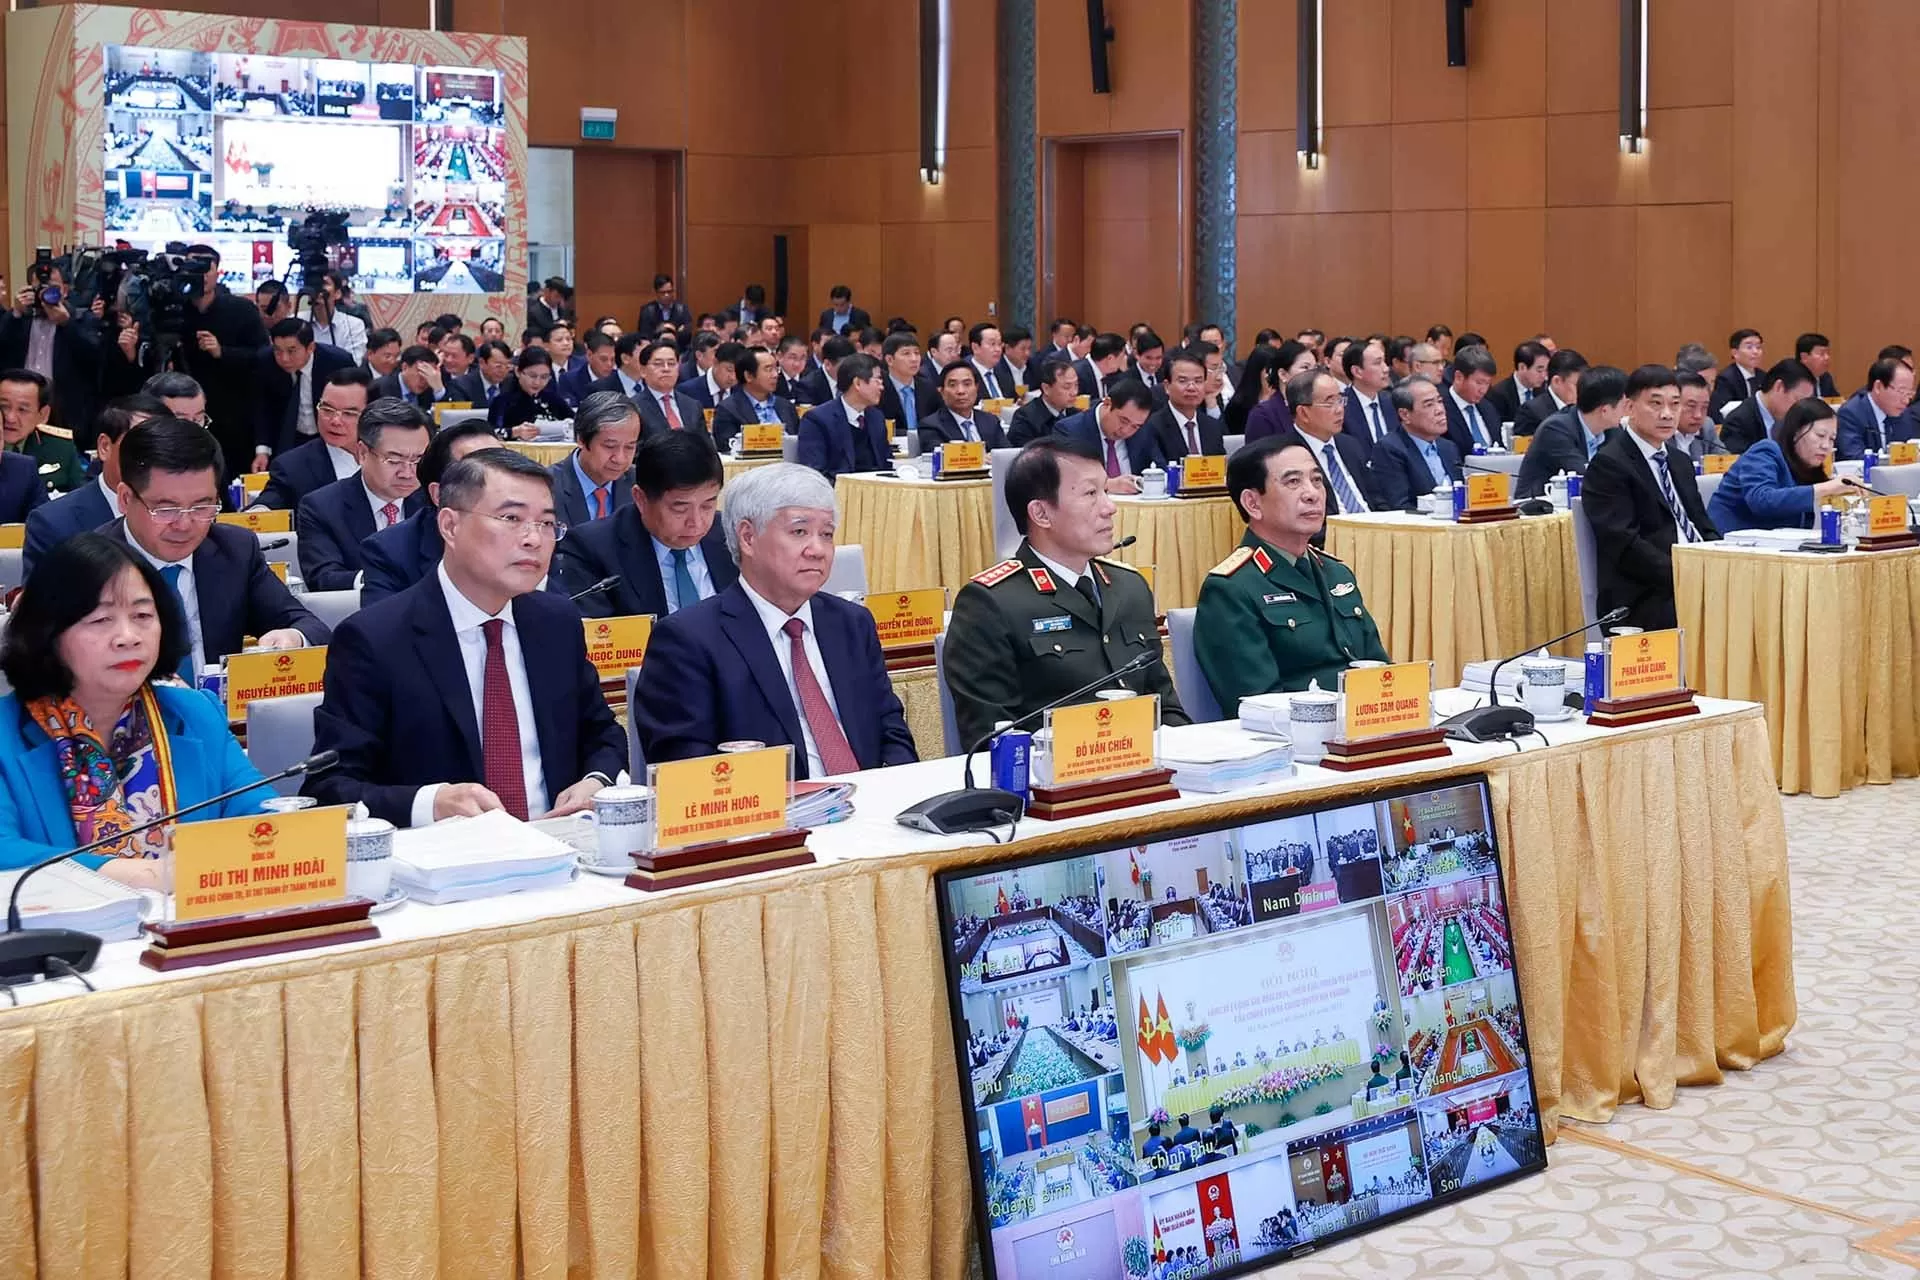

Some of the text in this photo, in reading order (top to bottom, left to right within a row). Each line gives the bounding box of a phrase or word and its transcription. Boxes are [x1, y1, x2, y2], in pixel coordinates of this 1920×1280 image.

[616, 648, 642, 659] DUNG
[237, 683, 277, 700] NGUYỄN
[279, 682, 306, 696] HỒNG
[685, 801, 697, 818] LÊ
[700, 799, 728, 816] MINH
[199, 857, 325, 888] BÙI THỊ MINH HOÀI
[1263, 897, 1290, 913] Nam
[960, 960, 997, 979] Nghe
[976, 1080, 1002, 1096] Phu
[1150, 1148, 1185, 1169] Chinh
[1440, 1176, 1461, 1192] Son
[991, 1195, 1035, 1217] Quang
